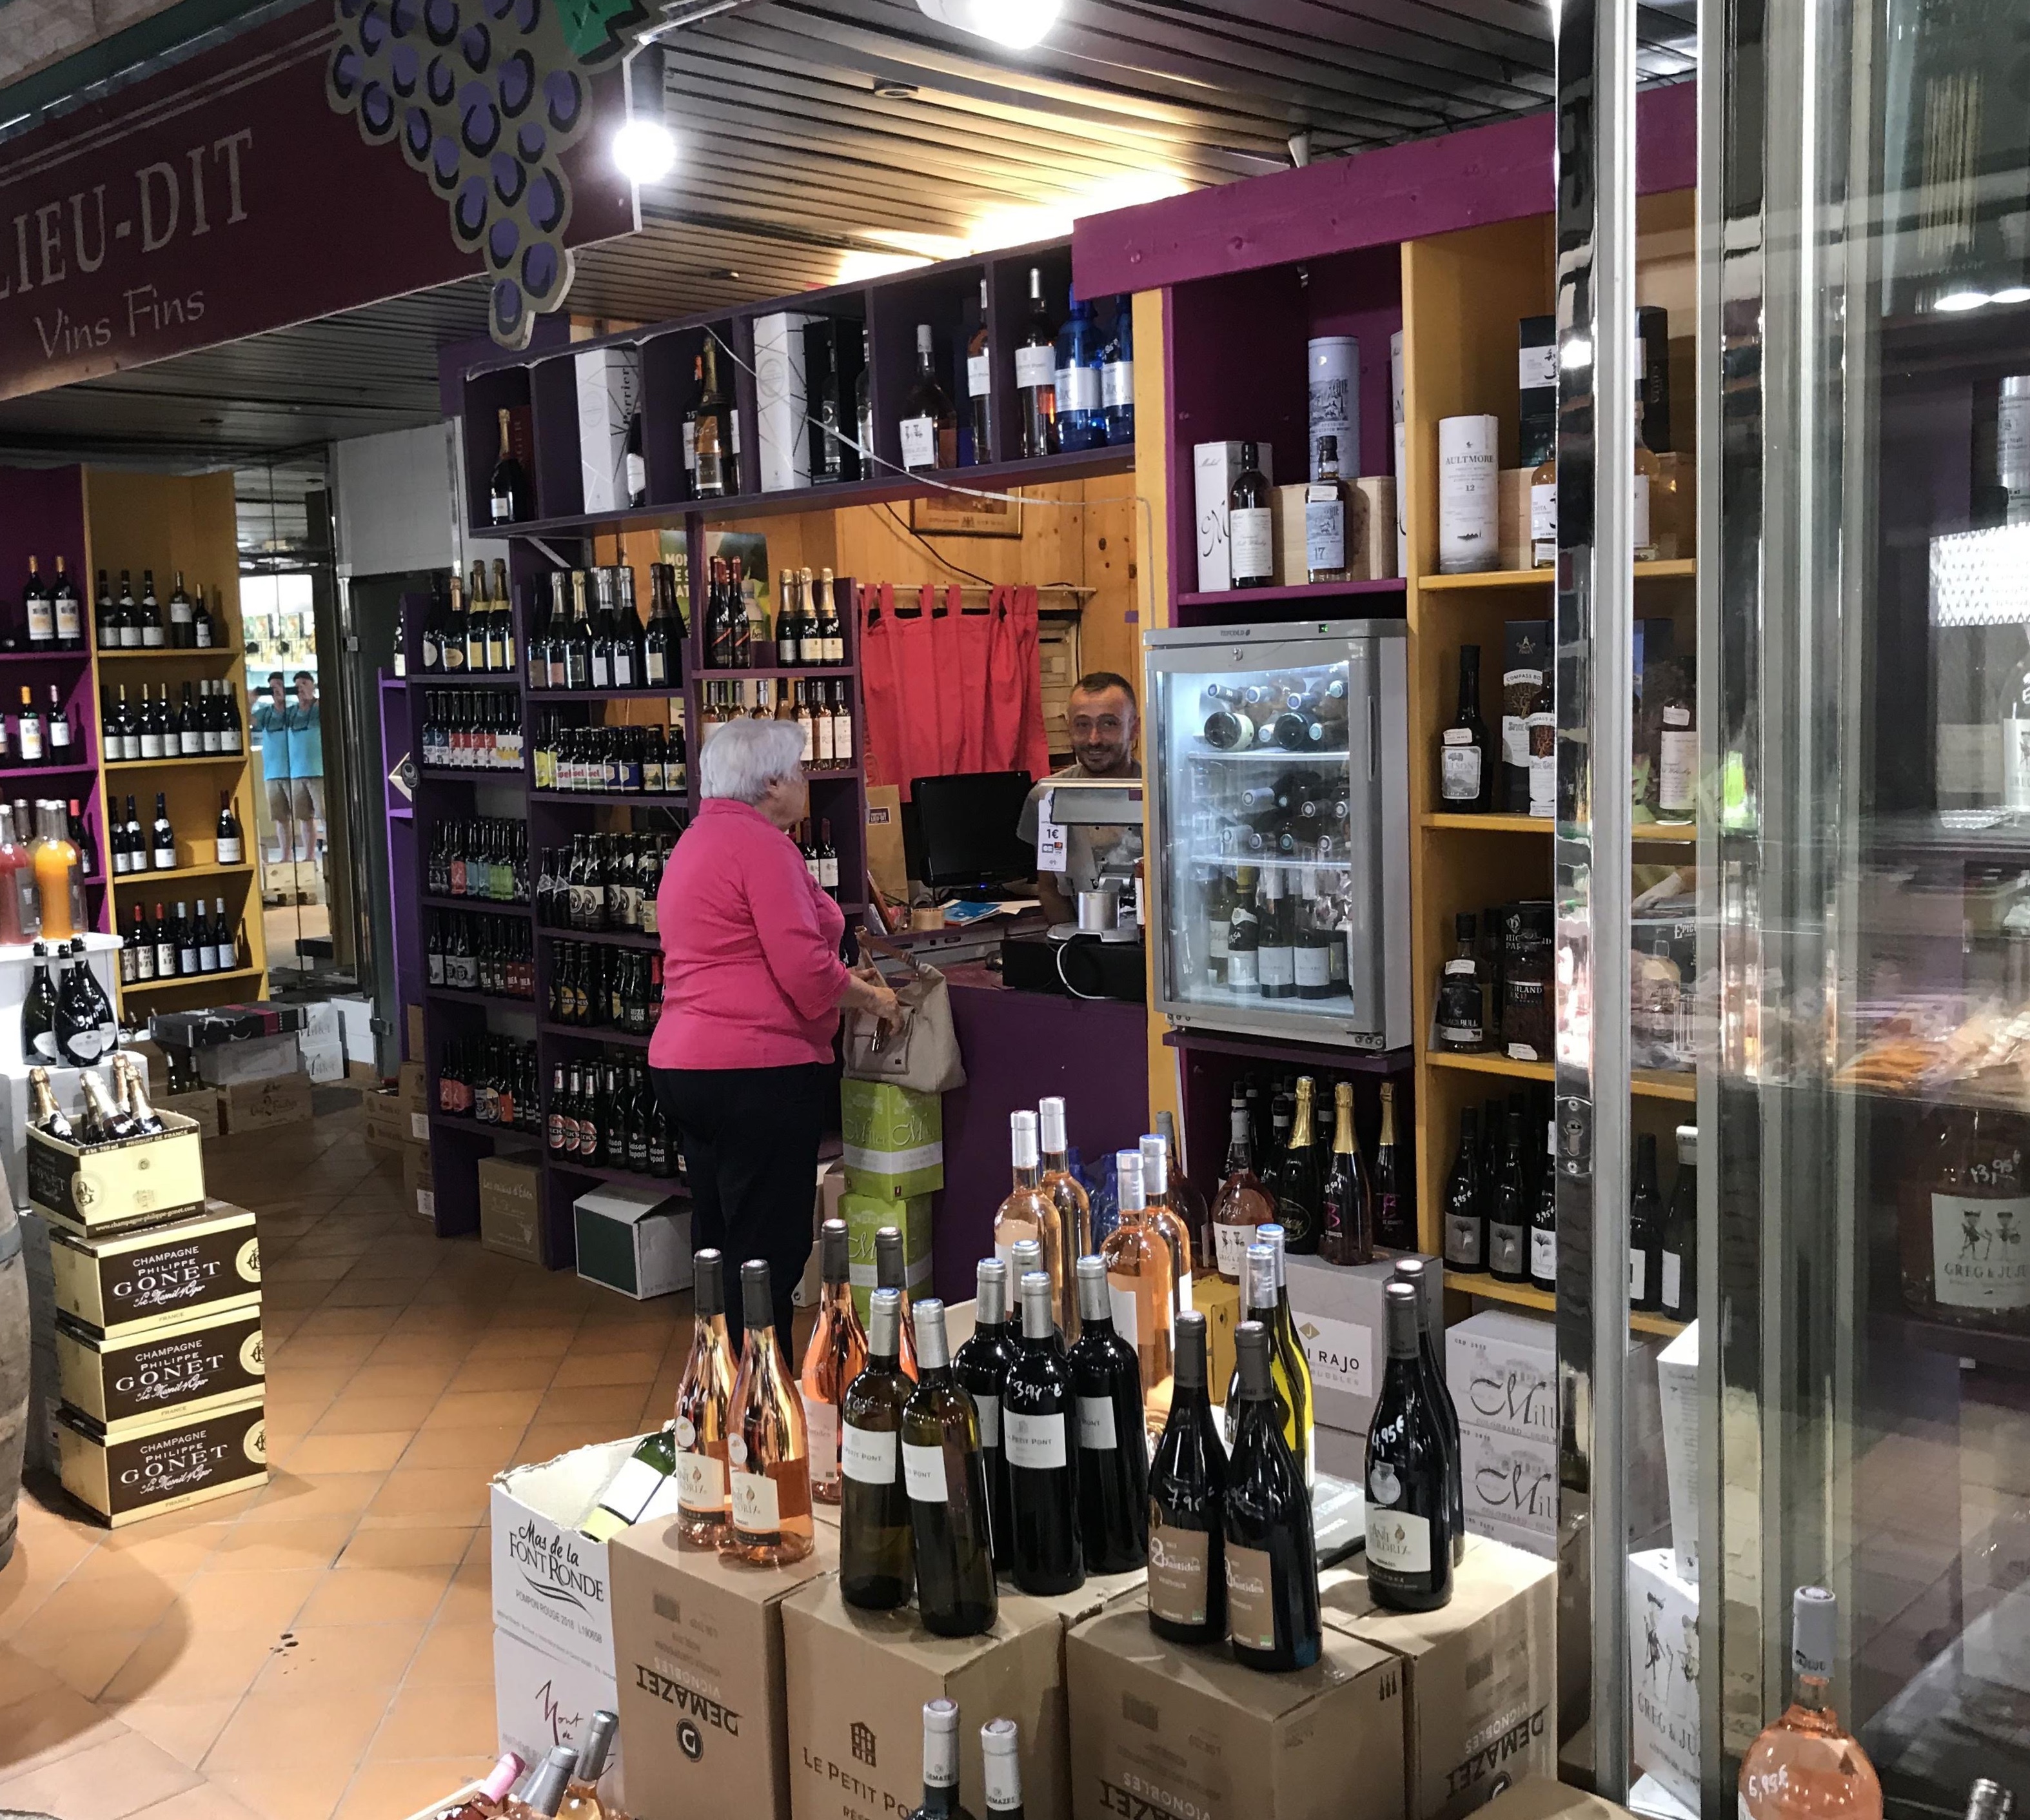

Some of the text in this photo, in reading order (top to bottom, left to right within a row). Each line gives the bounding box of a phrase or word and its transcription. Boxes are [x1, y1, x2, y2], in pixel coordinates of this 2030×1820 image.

[34, 284, 205, 358] Vins Fins
[1445, 455, 1493, 464] AULTMORE
[1314, 548, 1326, 560] 17
[1047, 829, 1059, 839] 1€
[126, 1138, 153, 1147] PRODUIT
[164, 1130, 188, 1140] FRANCE
[133, 1245, 199, 1267] CHAMPAGNE
[138, 1258, 196, 1276] PHILIPPE
[113, 1261, 221, 1296] GONET
[159, 1312, 184, 1322] FRANCE
[135, 1340, 202, 1362] CHAMPAGNE
[141, 1352, 199, 1371] PHILIPPE
[1319, 1350, 1359, 1373] RAJO
[115, 1354, 224, 1391] GONET
[161, 1406, 187, 1415] FRANCE
[140, 1430, 207, 1454] CHAMPAGNE
[1372, 1414, 1404, 1458] 4,95€
[121, 1445, 228, 1483] GONET
[146, 1443, 203, 1463] PHILIPPE
[862, 1452, 882, 1462] PONT
[165, 1496, 191, 1507] FRANCE
[518, 1518, 578, 1567] Mas de la
[509, 1531, 604, 1603] FONT RONDE
[516, 1588, 539, 1611] POMPON
[540, 1605, 561, 1623] ROUGE
[561, 1614, 575, 1630] 2018
[654, 1656, 721, 1699] VIGNOBLES
[633, 1662, 743, 1737] DEMAZET
[1465, 1701, 1528, 1754] VIGNOBLES
[1637, 1692, 1666, 1734] GREG
[1669, 1725, 1675, 1741] &
[1444, 1703, 1550, 1800] DEMAZET
[803, 1746, 914, 1820] LE PETIT PO
